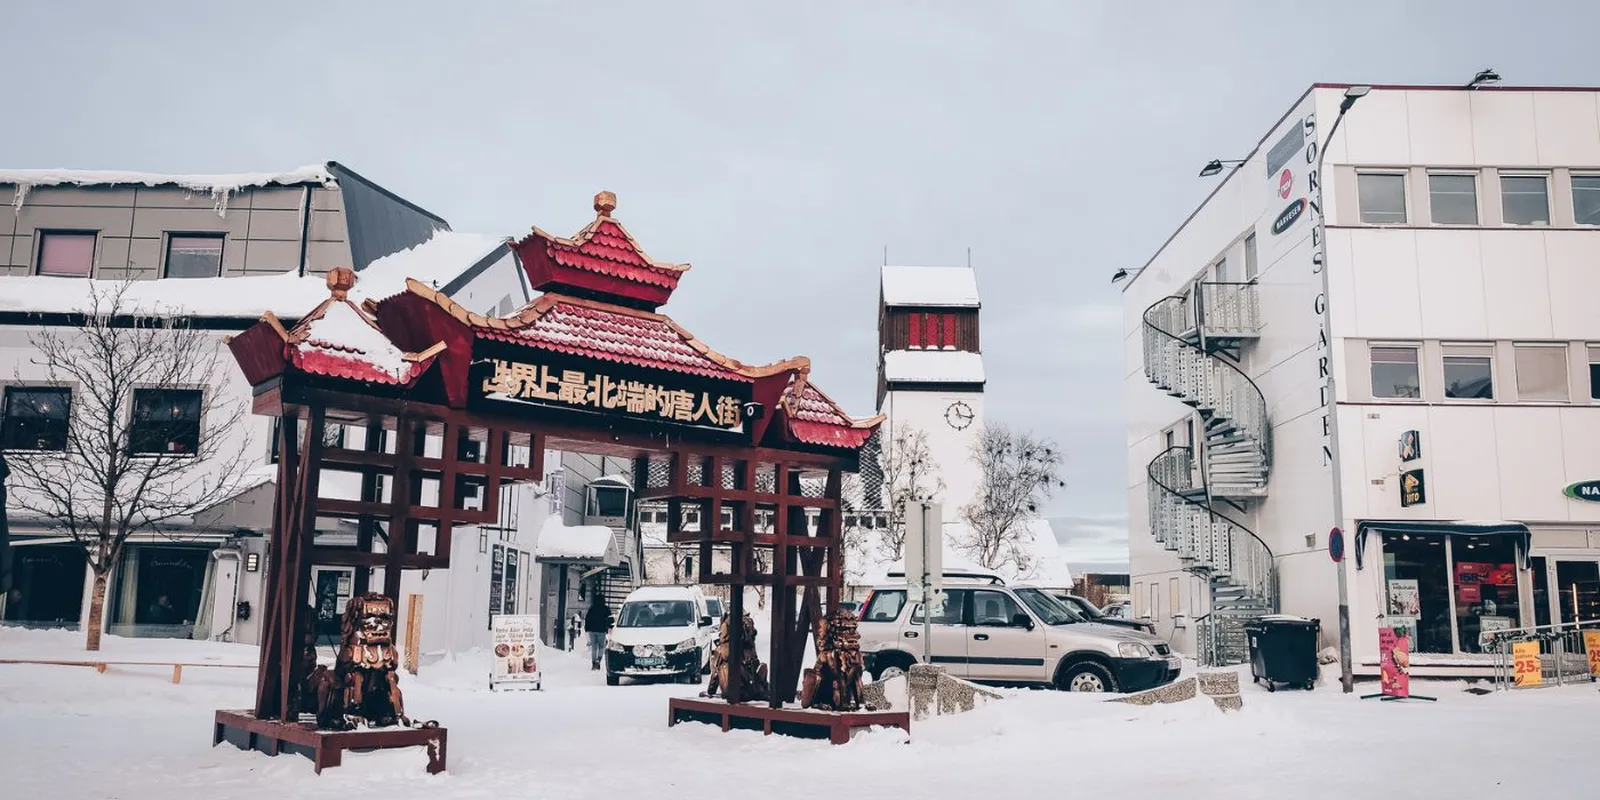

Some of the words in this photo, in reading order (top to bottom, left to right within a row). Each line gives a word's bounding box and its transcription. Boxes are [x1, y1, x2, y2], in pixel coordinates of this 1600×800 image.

[1276, 204, 1302, 230] NARVESEN
[482, 358, 741, 428] 世界上最北端的唐人街
